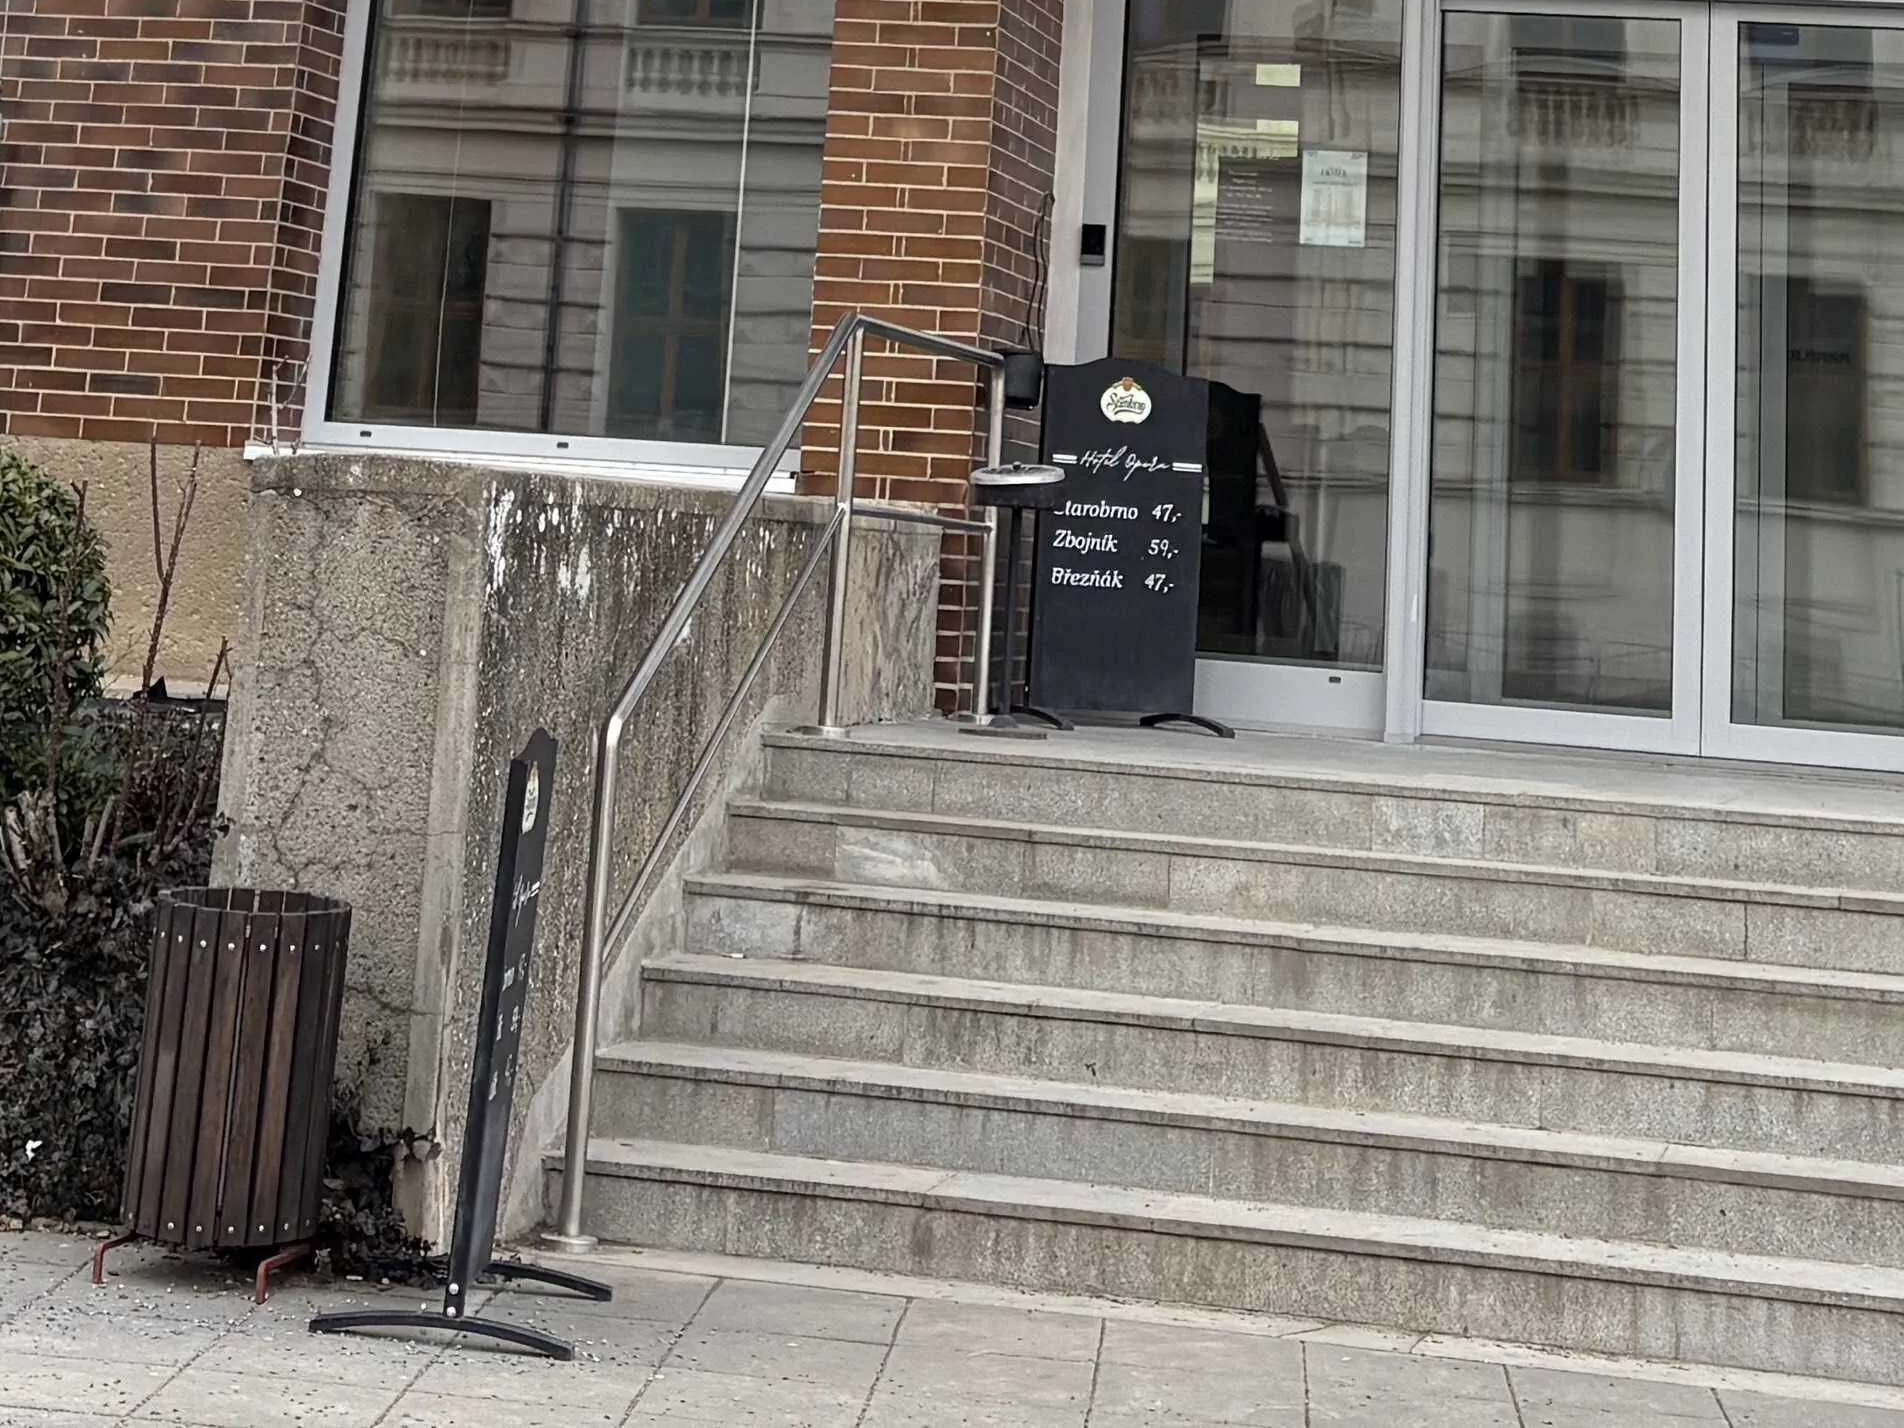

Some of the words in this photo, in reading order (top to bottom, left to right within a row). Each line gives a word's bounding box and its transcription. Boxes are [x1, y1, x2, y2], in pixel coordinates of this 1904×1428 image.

[1053, 500, 1138, 521] tarobrno
[1151, 504, 1182, 523] 47,-
[1052, 529, 1118, 554] Zbojník
[1148, 539, 1179, 559] 59,-
[1051, 567, 1124, 589] Březňák
[1144, 573, 1175, 593] 47,-
